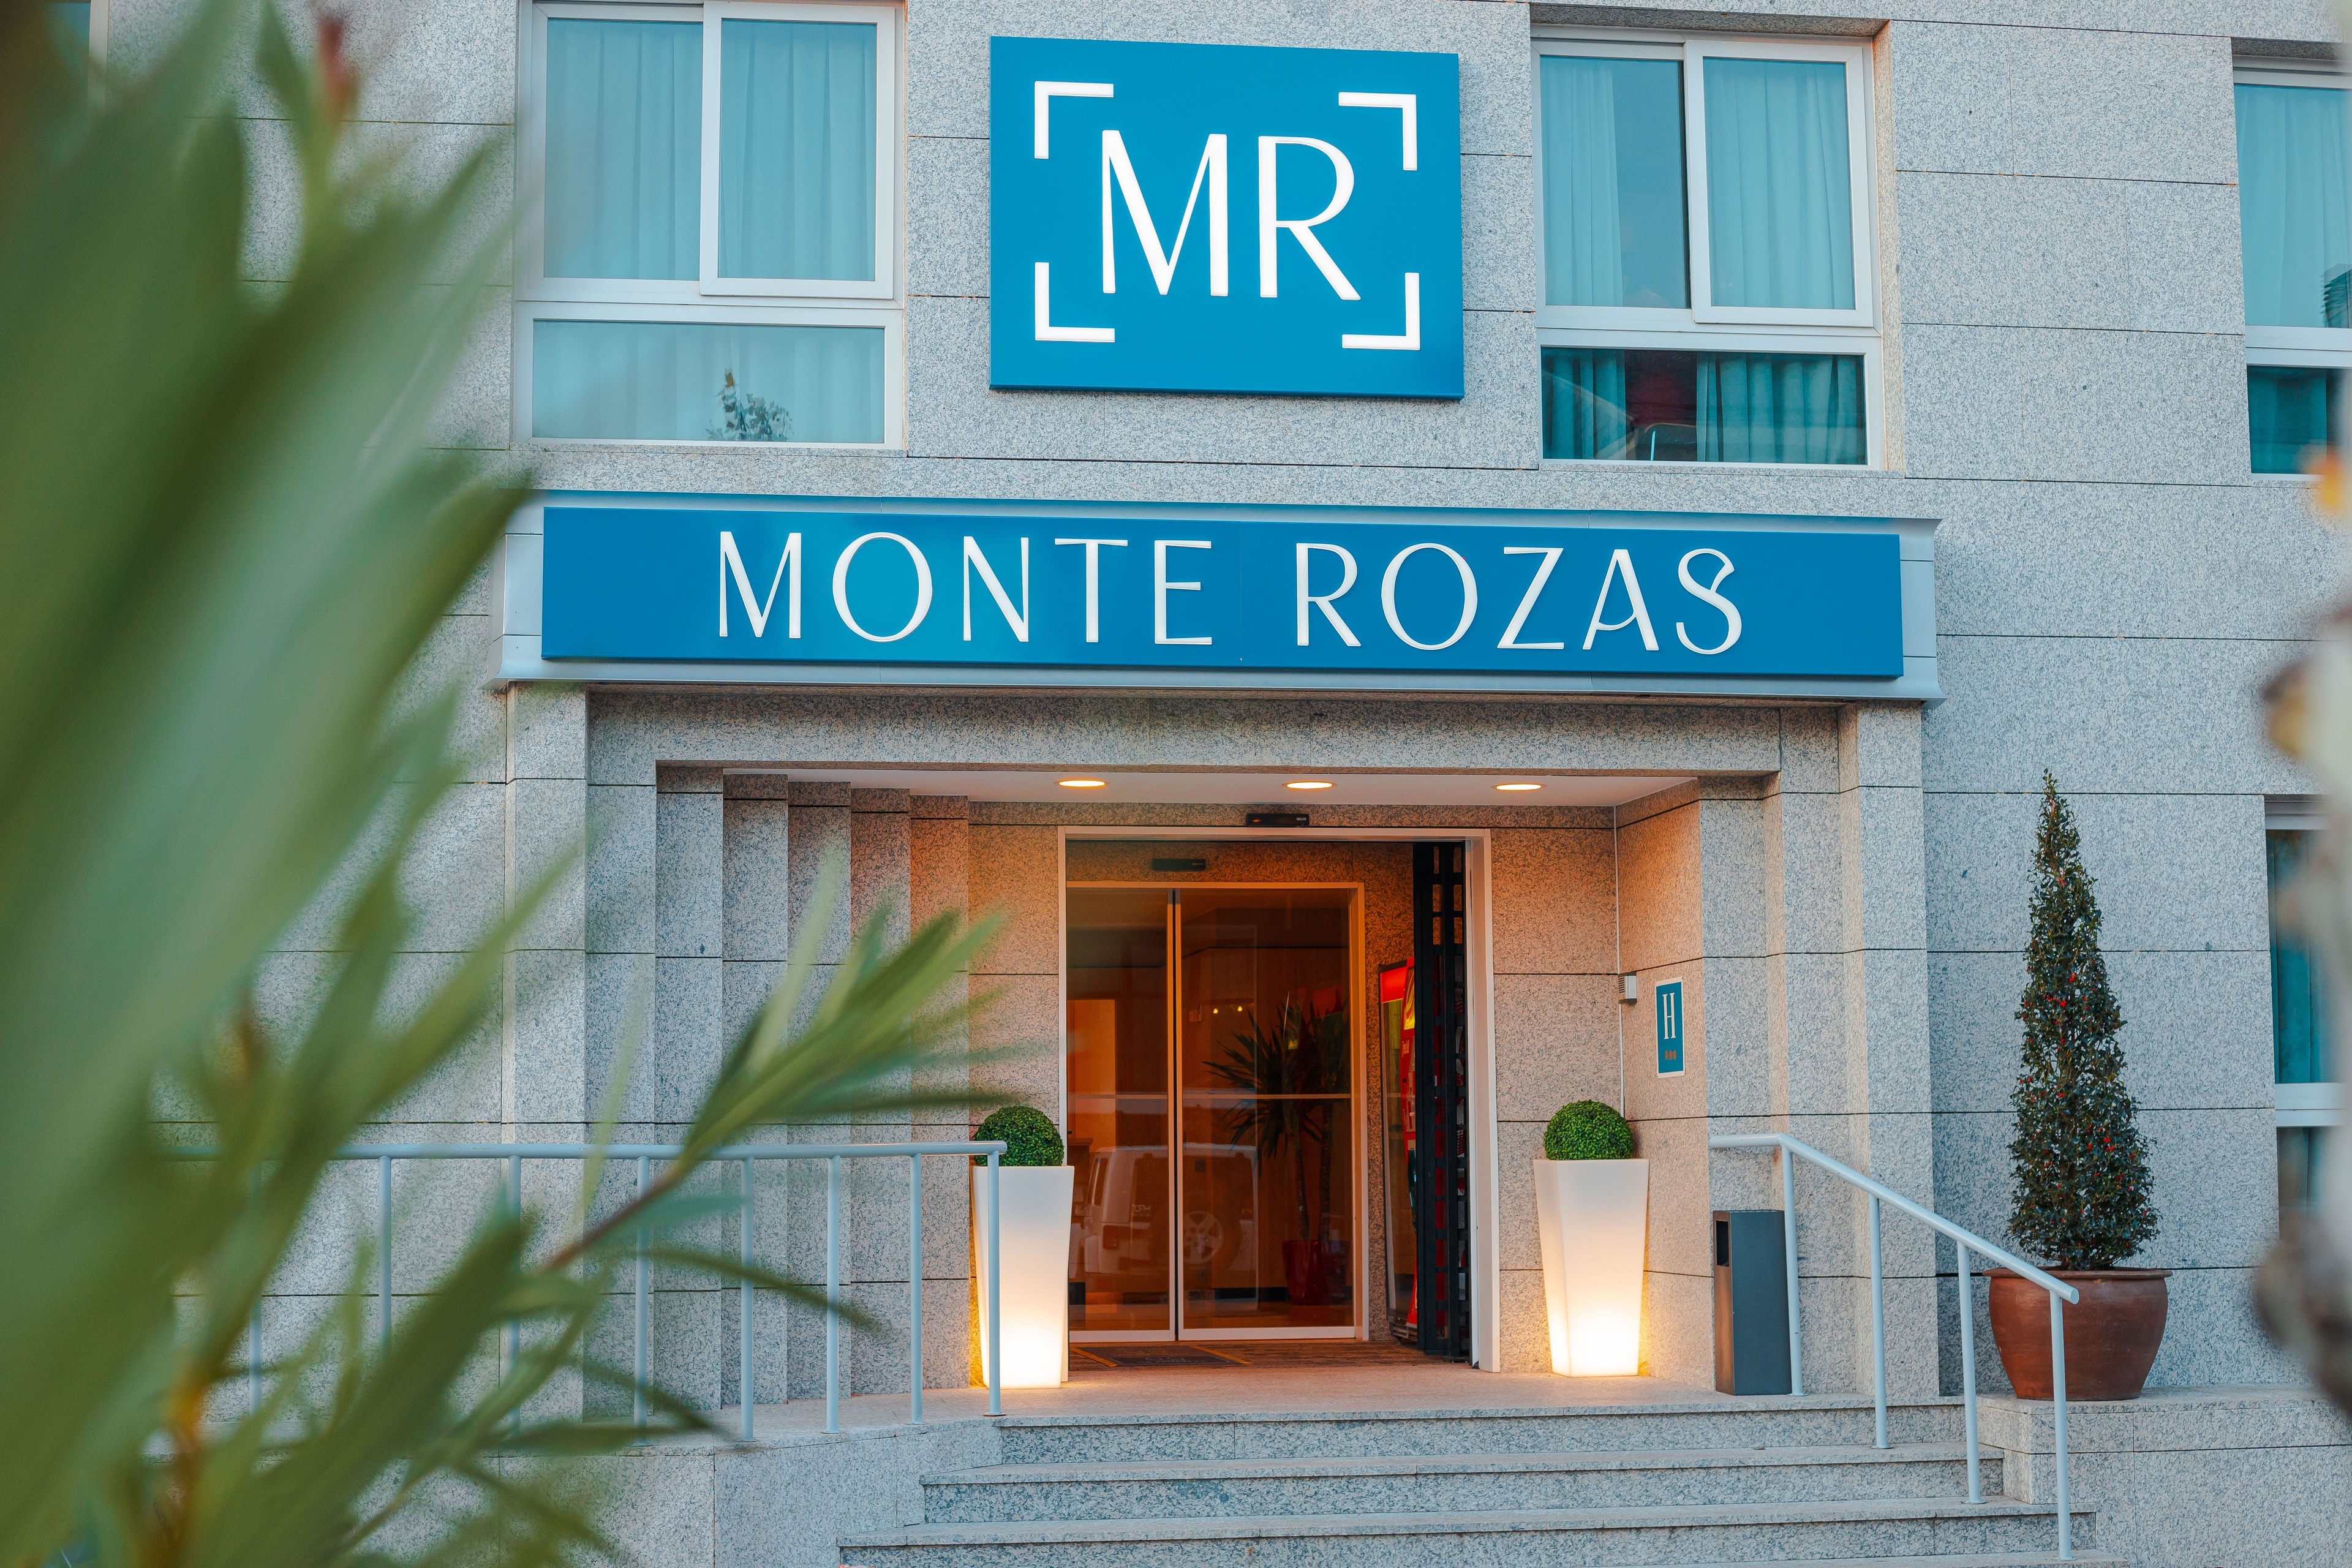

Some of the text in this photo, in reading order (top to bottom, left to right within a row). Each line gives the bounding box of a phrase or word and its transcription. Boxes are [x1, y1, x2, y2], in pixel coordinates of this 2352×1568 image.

[1102, 129, 1361, 301] MR
[719, 531, 1742, 655] MONTE ROZAS
[1662, 992, 1676, 1039] H
